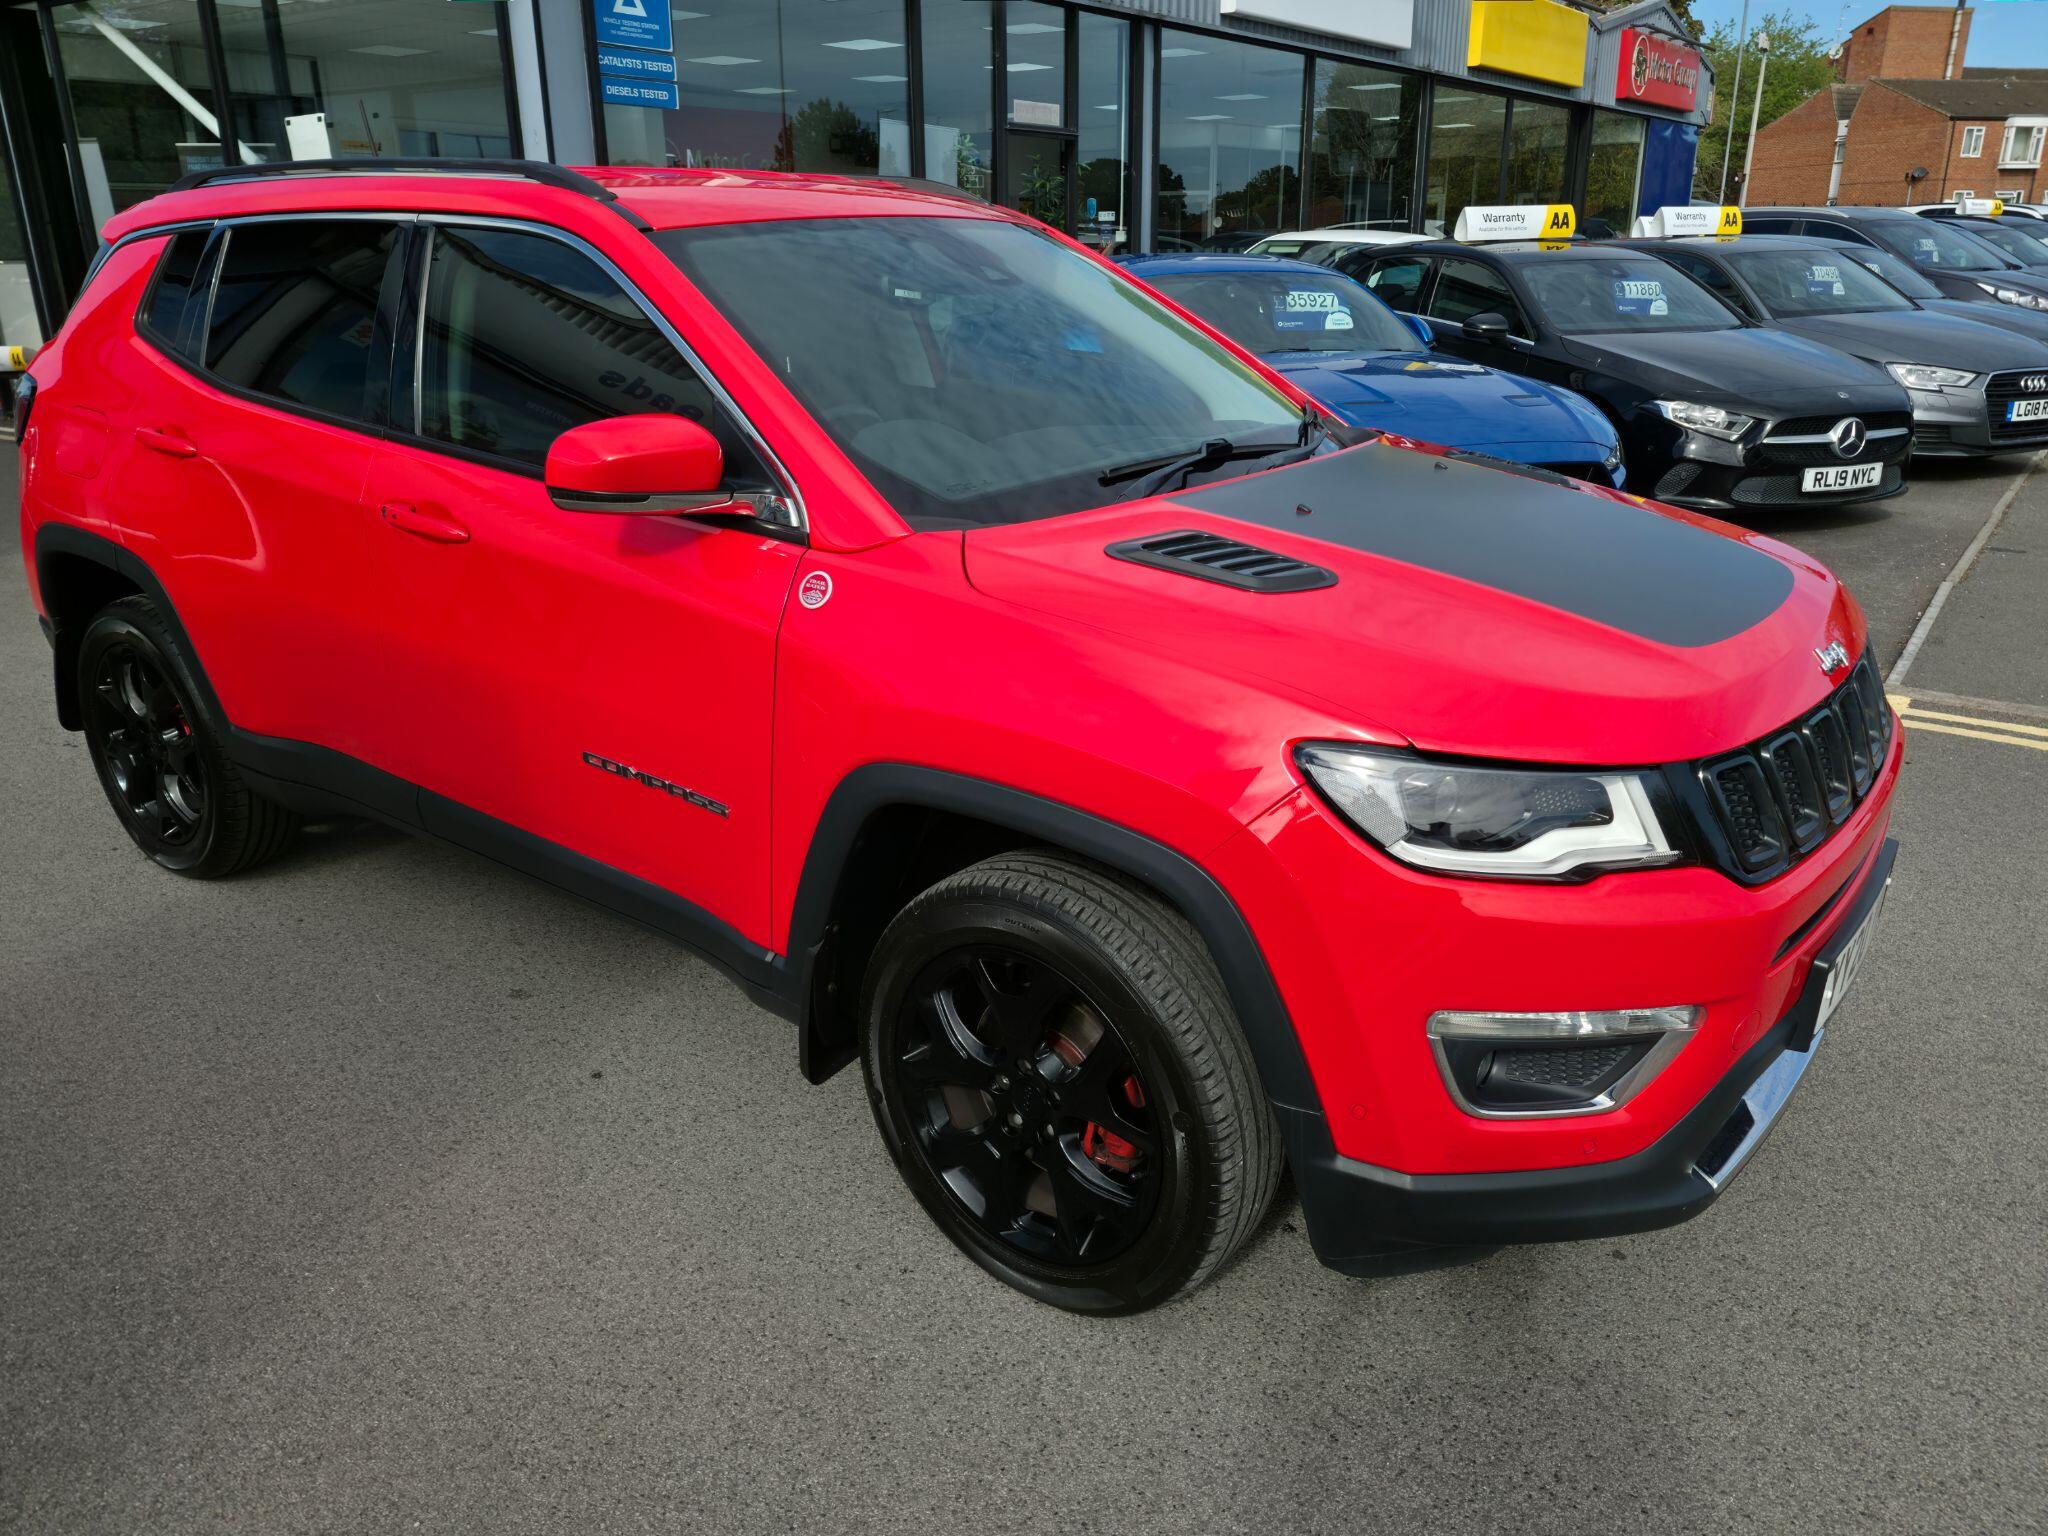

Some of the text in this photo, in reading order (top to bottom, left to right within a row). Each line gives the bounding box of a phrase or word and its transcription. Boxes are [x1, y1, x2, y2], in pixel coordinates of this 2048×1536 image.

[621, 20, 641, 28] TESTING
[641, 22, 660, 30] STATION
[598, 54, 673, 73] CATALYSTS TESTED
[606, 85, 669, 100] DIESELS TESTED
[1482, 211, 1570, 230] Warranty AA
[1675, 212, 1738, 227] Warranty AA
[2041, 401, 2048, 415] R
[1813, 466, 1876, 488] RL19 NYC
[582, 751, 730, 819] COMPASS
